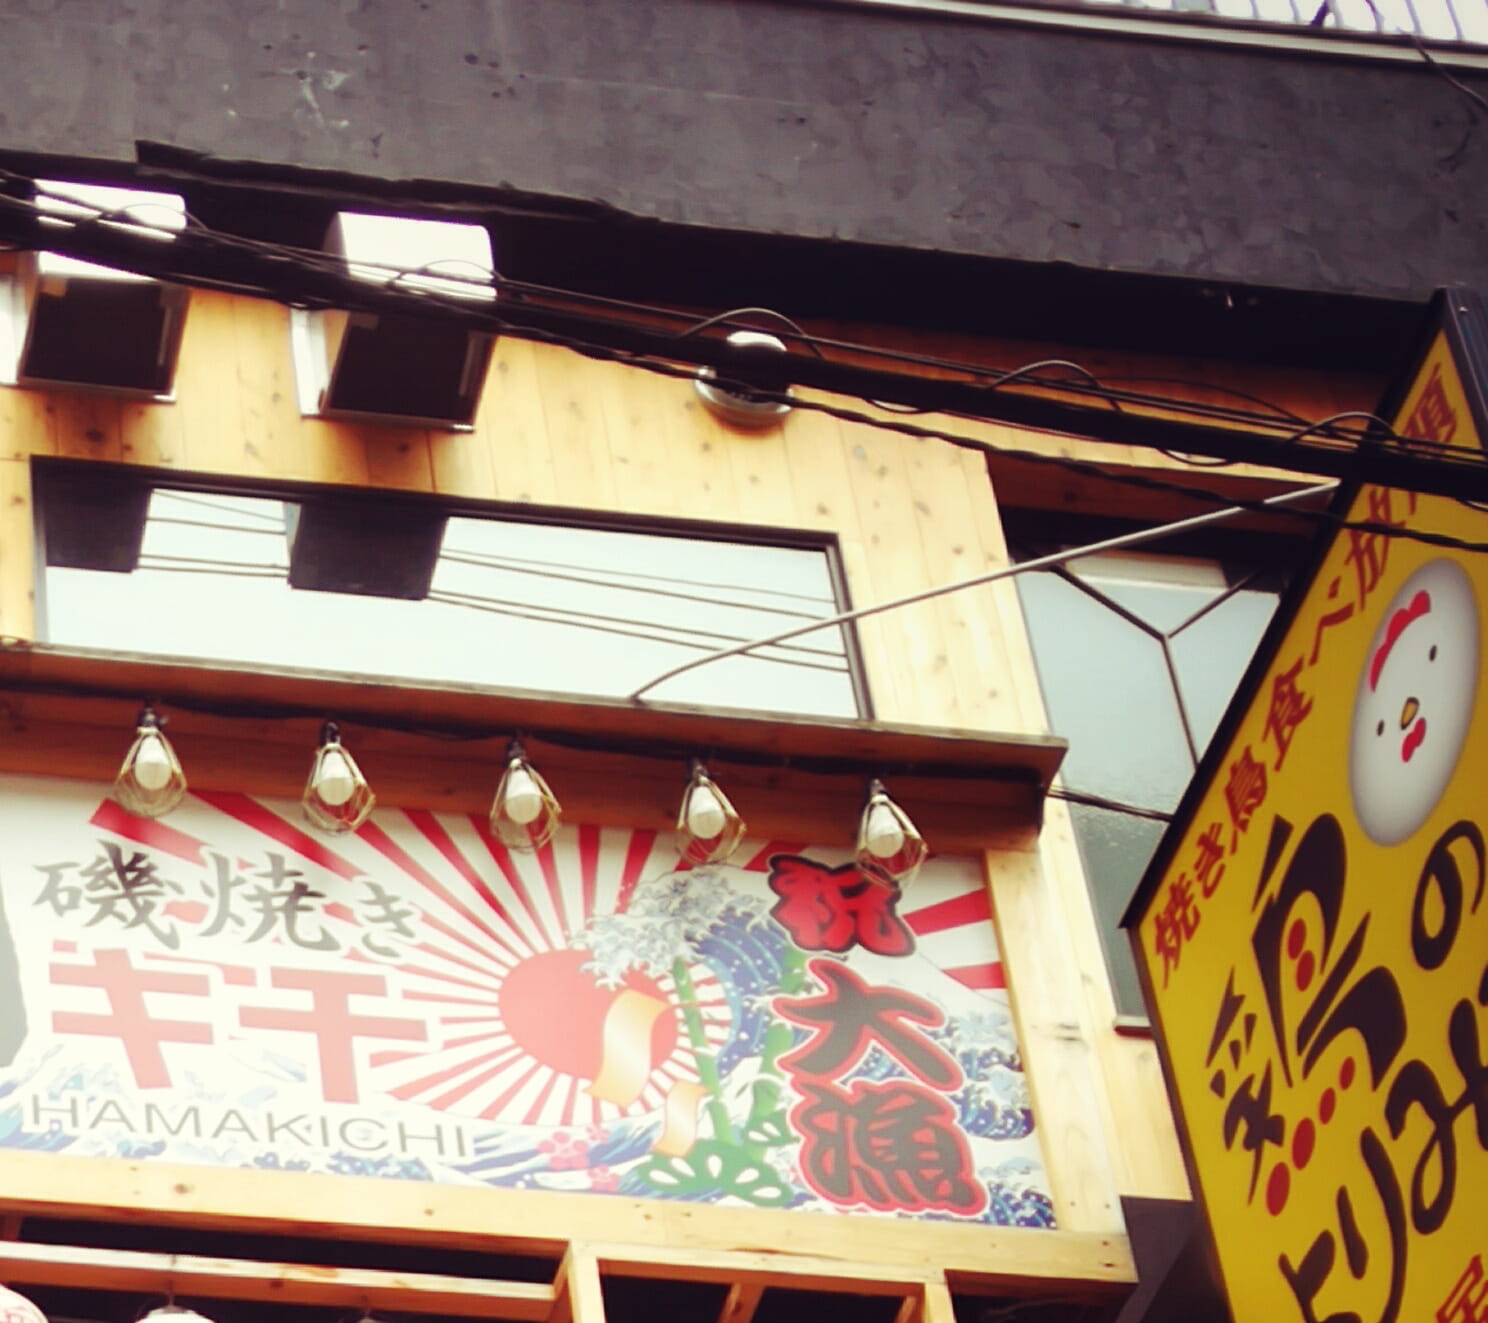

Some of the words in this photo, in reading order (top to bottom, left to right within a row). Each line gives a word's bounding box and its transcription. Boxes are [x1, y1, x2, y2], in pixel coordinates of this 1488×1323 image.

[33, 838, 420, 961] 磯焼き
[31, 1093, 469, 1159] HAMAKICHI
[771, 957, 990, 1216] 大漁
